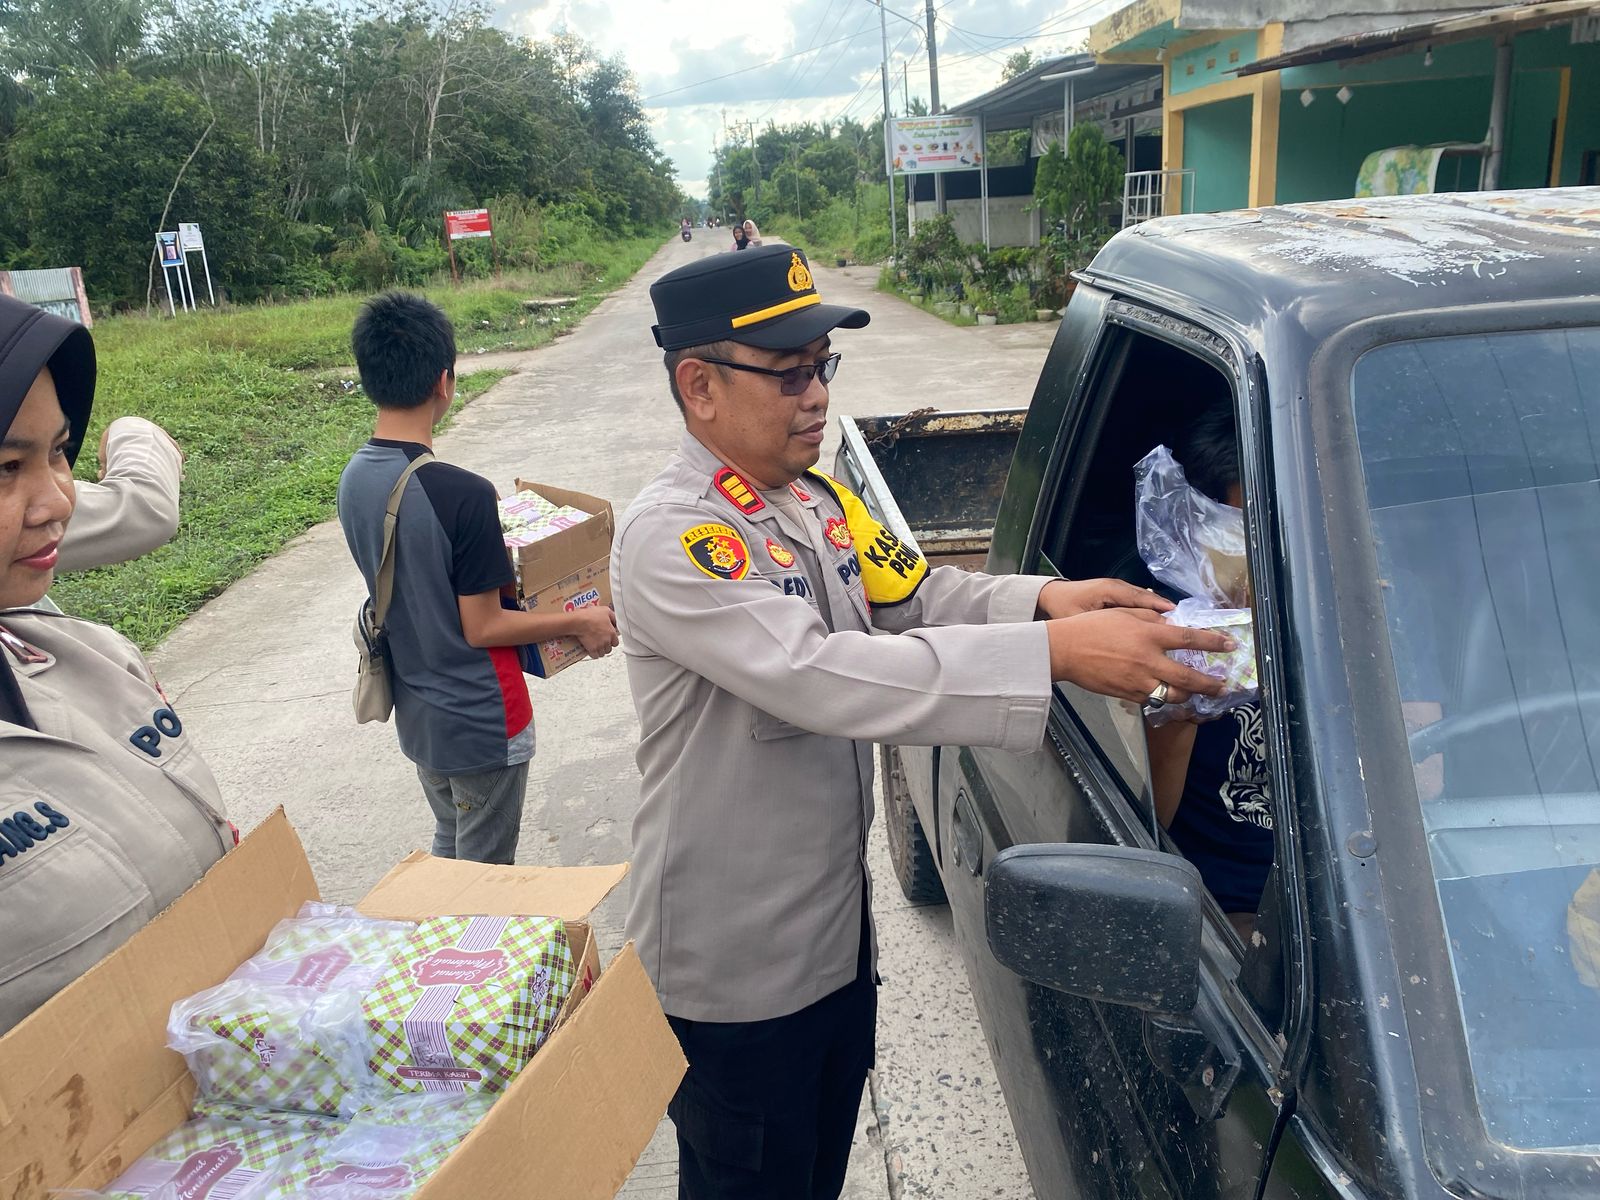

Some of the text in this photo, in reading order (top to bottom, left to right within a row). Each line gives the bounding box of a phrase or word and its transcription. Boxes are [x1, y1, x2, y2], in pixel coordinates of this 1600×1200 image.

[573, 589, 598, 607] MEGA
[431, 958, 496, 970] Menikmati
[430, 969, 482, 981] Selamat
[407, 1069, 470, 1079] TERIMA KASIH
